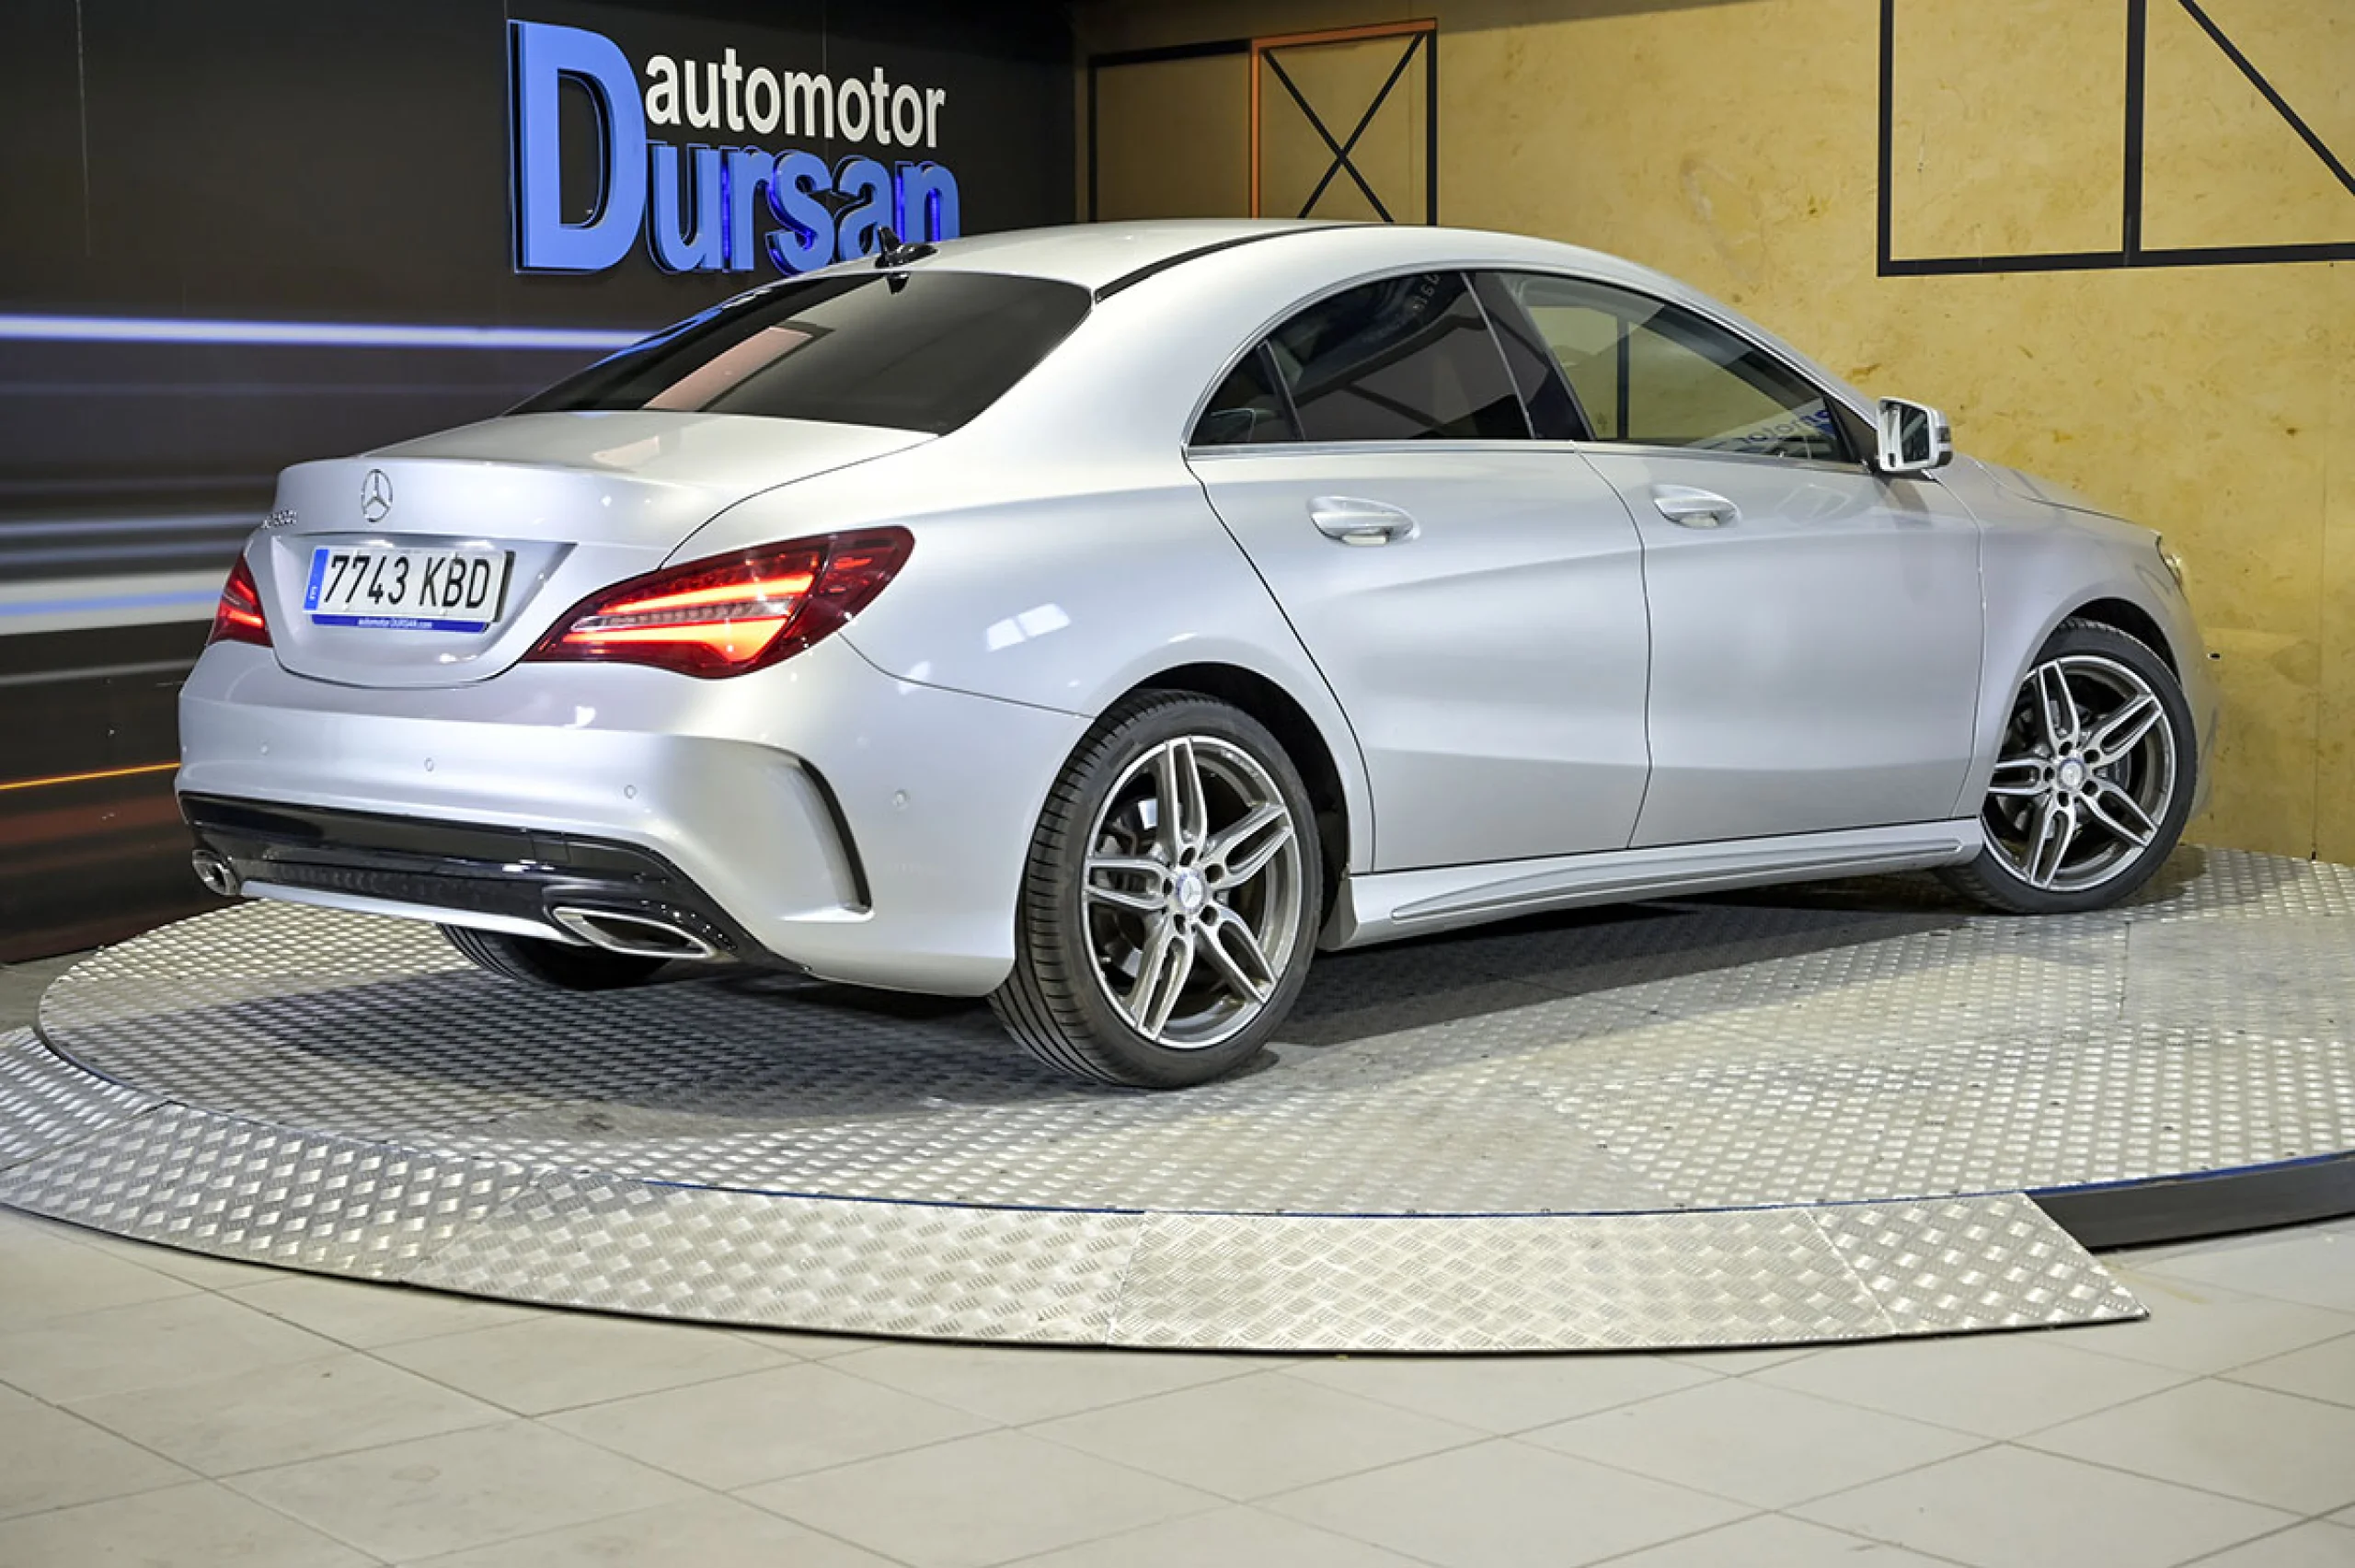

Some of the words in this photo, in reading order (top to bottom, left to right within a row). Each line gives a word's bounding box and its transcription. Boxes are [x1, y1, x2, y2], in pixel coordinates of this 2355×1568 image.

[508, 18, 960, 276] Dursan
[645, 47, 946, 148] automotor
[324, 555, 409, 605] 7743
[419, 556, 491, 609] KBD
